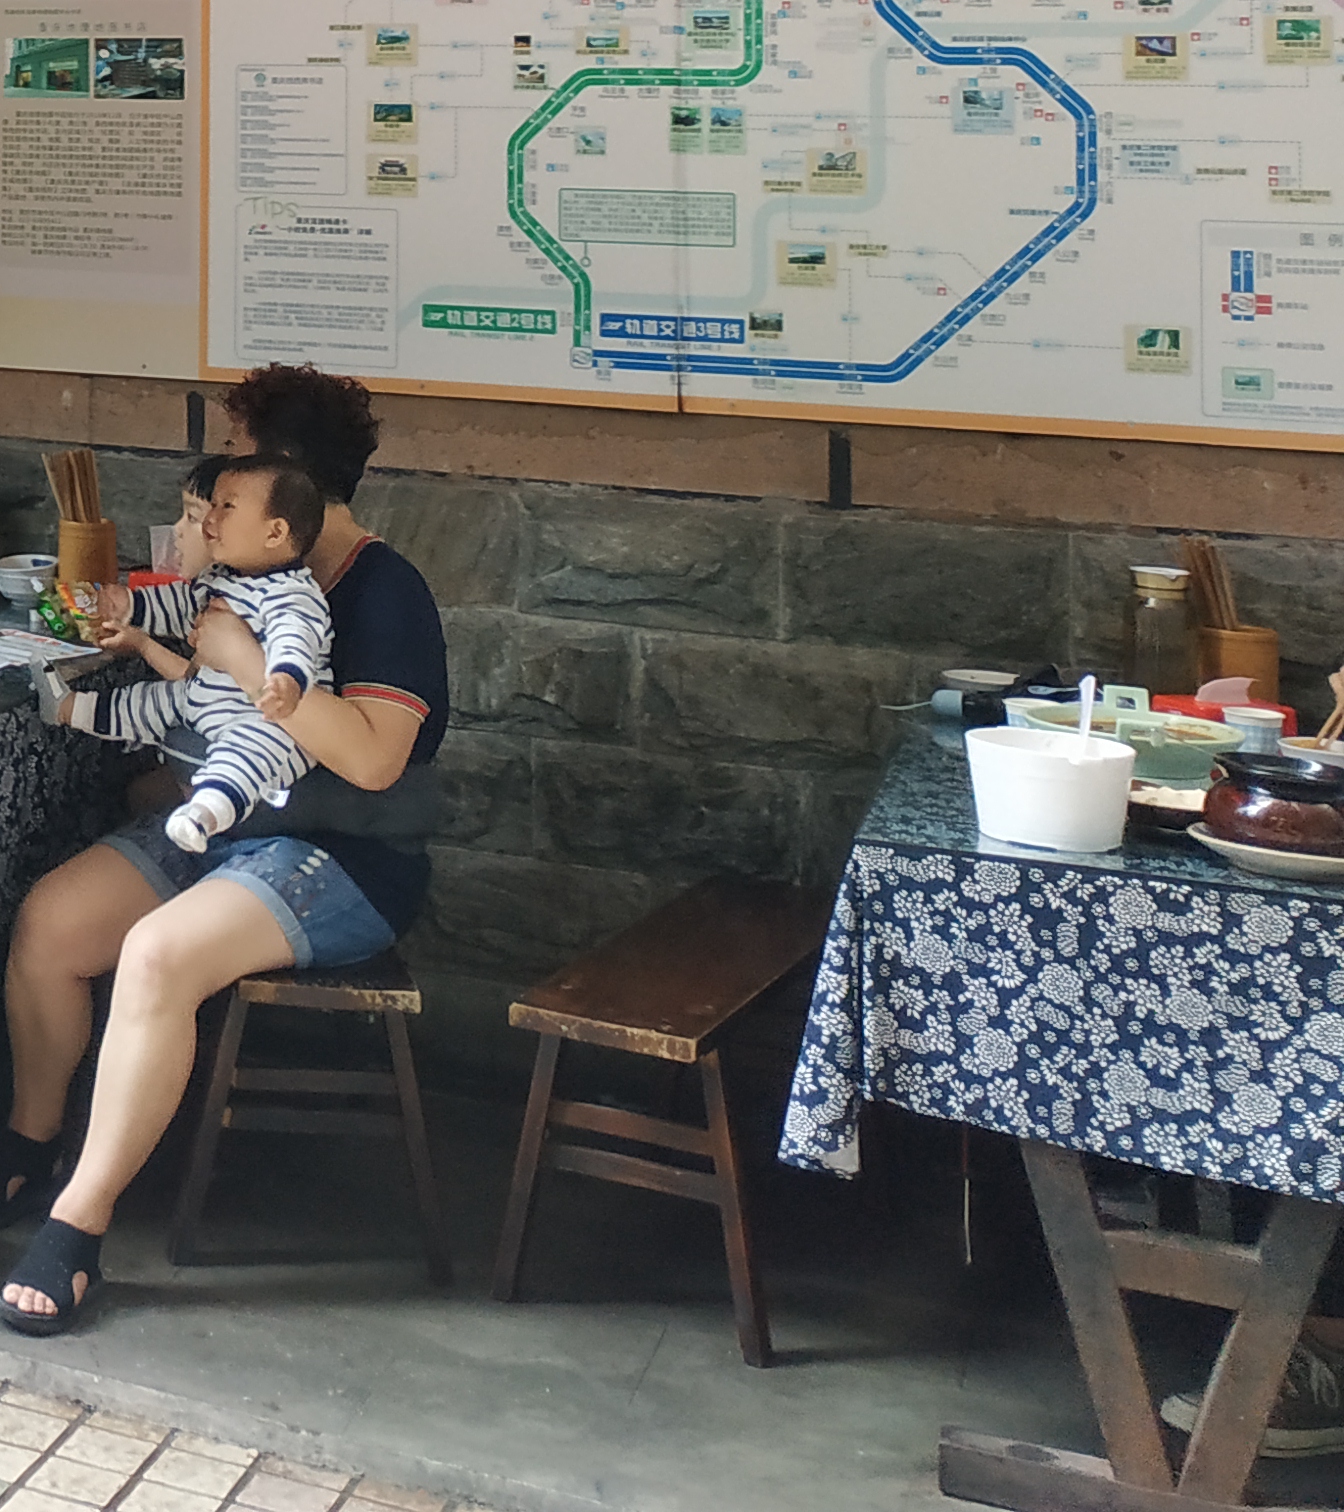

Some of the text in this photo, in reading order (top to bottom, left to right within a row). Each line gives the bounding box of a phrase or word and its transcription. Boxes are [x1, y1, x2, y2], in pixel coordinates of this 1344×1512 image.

[243, 195, 300, 219] Tips
[446, 309, 553, 331] 轨道交通2号线
[624, 318, 741, 340] 轨道交通3号线
